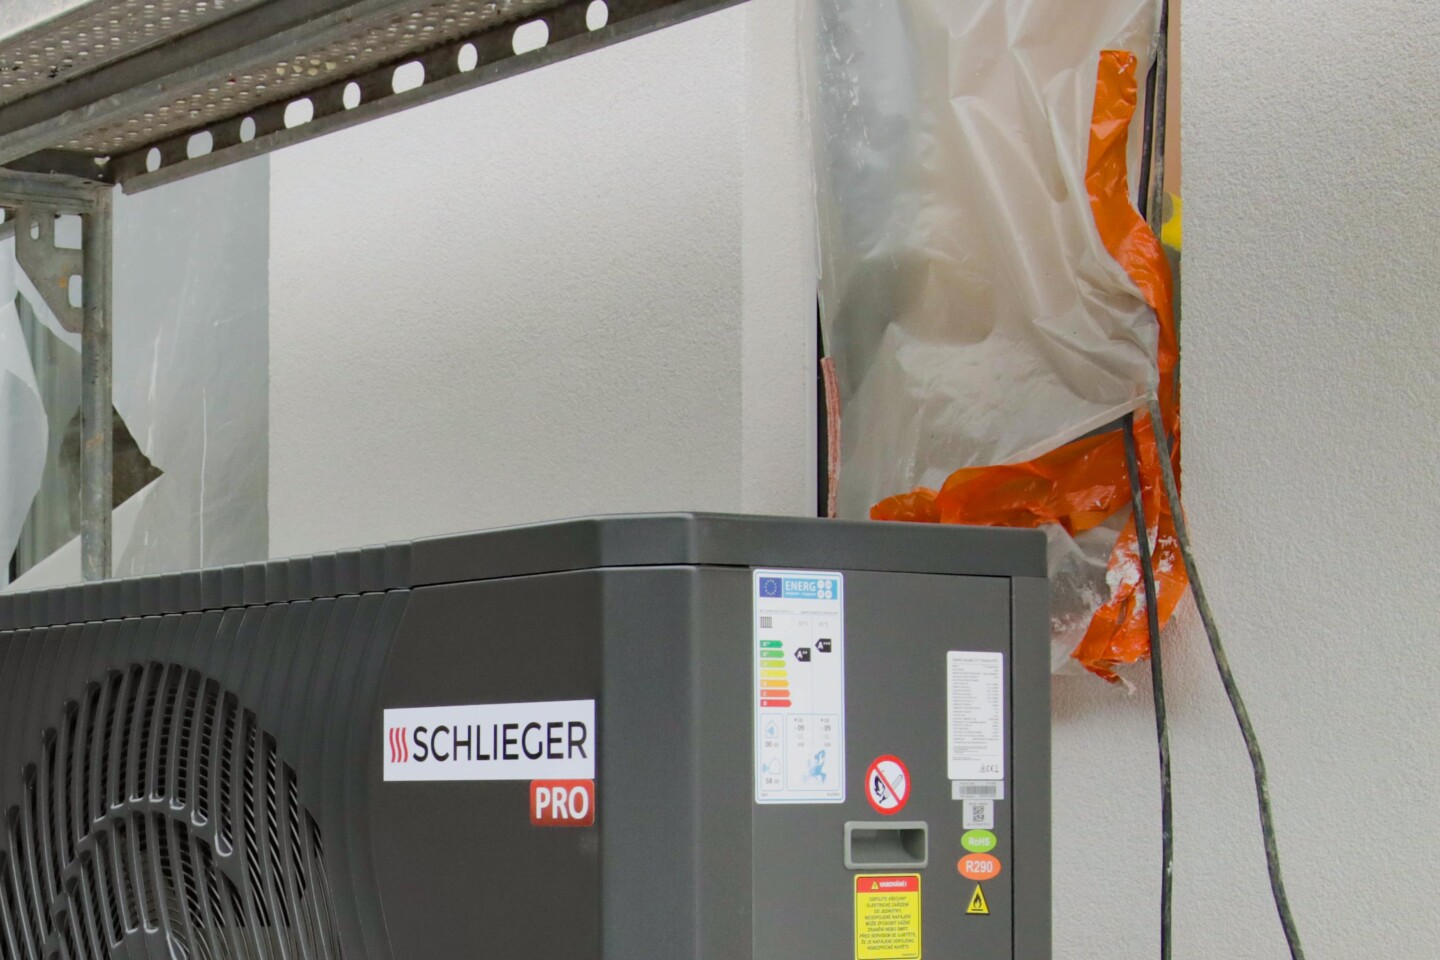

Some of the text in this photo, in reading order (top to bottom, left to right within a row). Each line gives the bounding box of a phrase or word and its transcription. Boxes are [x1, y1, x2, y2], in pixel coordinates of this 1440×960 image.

[785, 580, 816, 592] ENERG
[412, 721, 588, 763] SCHLIEGER
[535, 786, 589, 819] PRO
[968, 837, 990, 846] RoHS
[965, 861, 993, 873] R290
